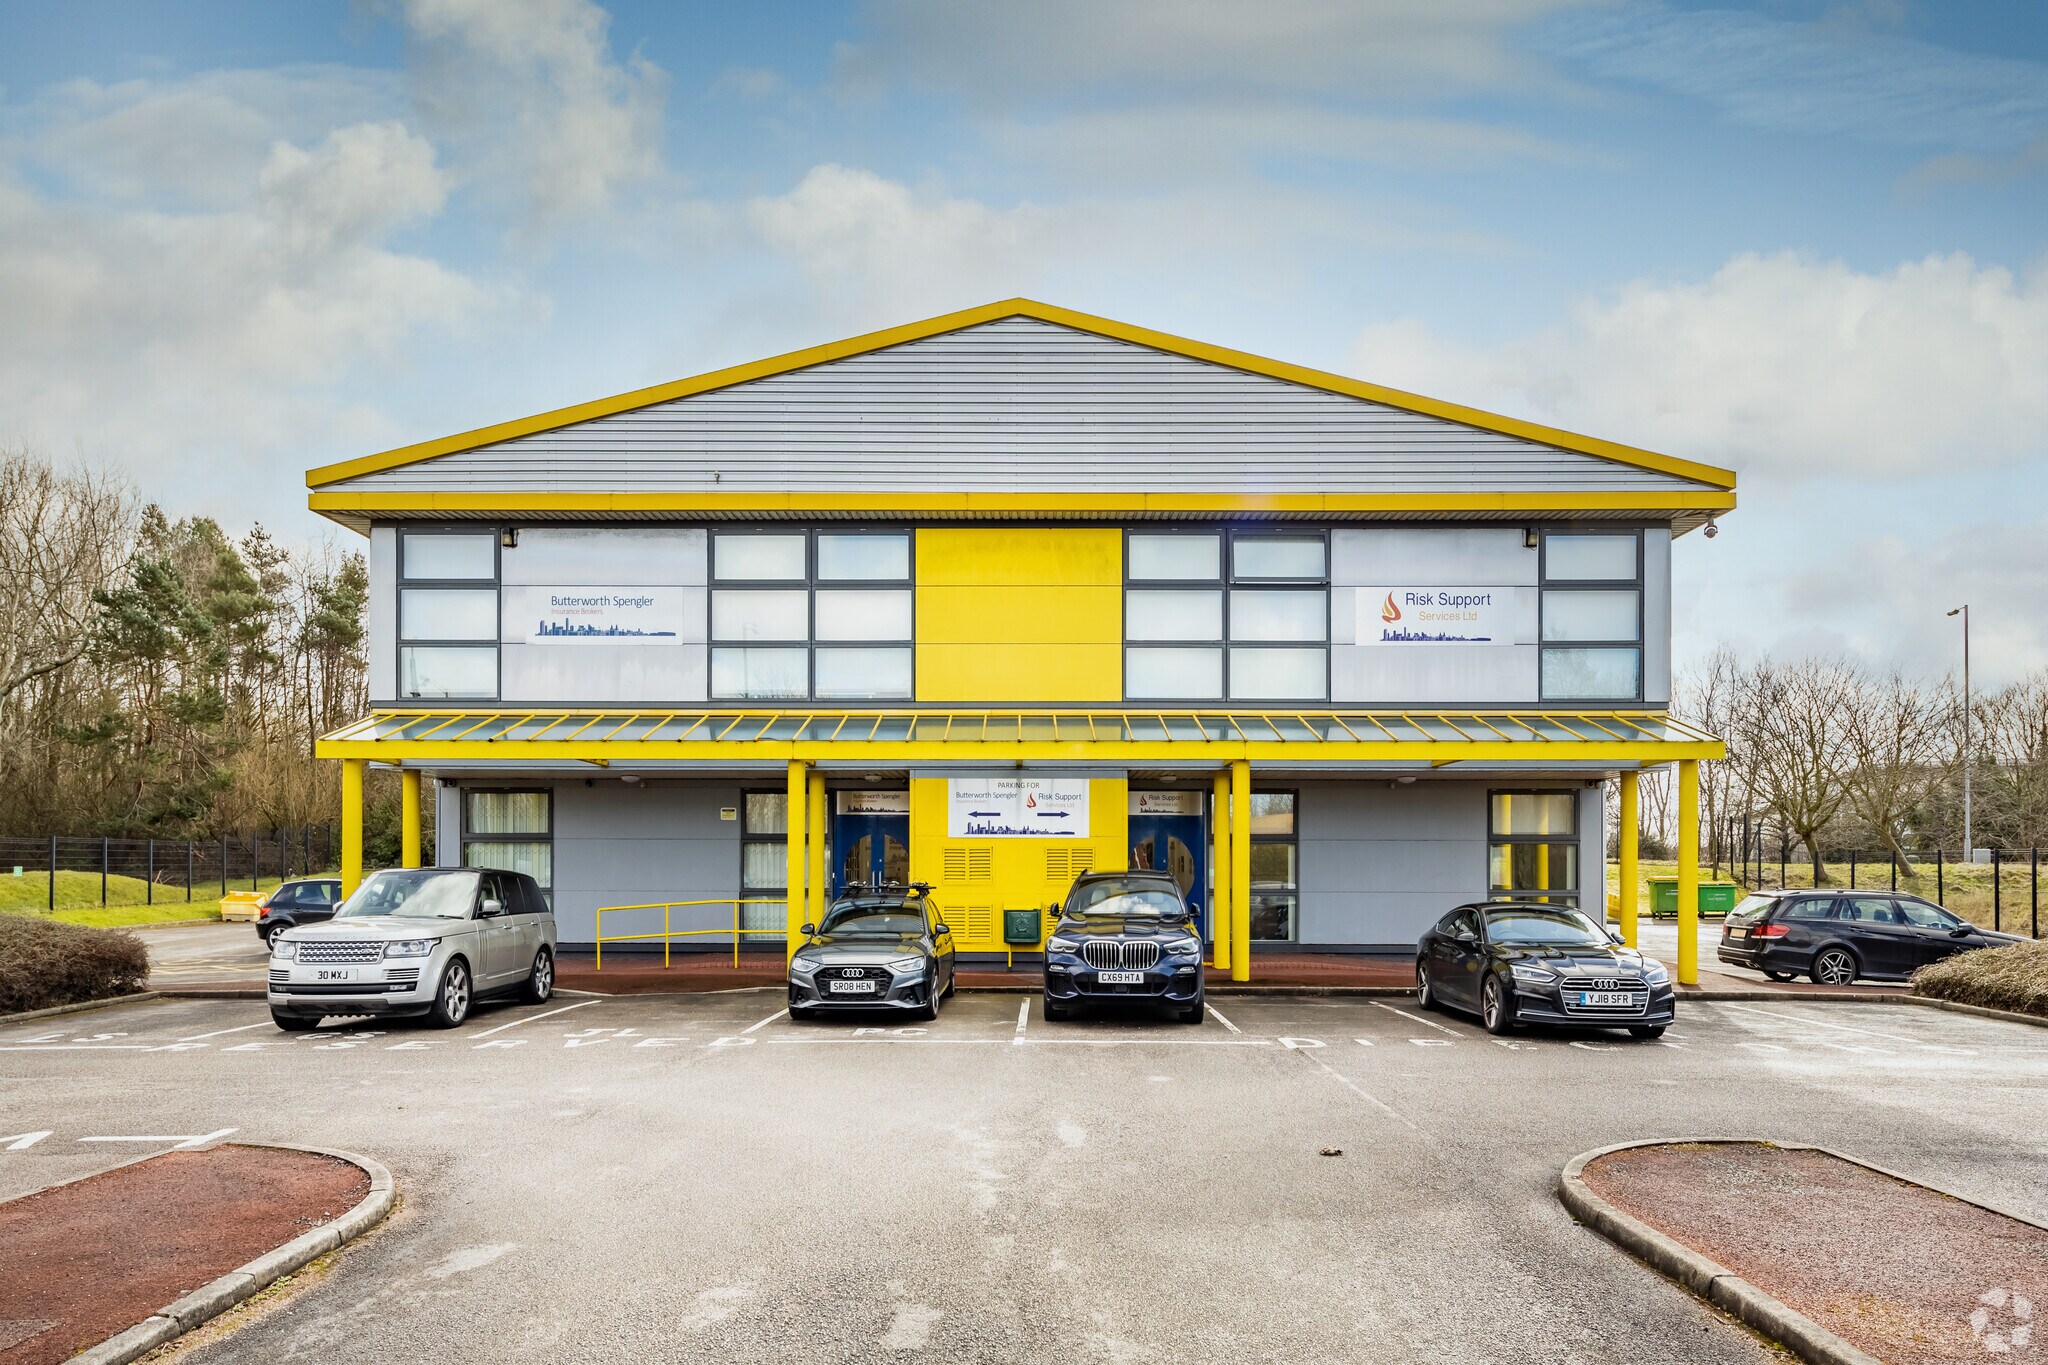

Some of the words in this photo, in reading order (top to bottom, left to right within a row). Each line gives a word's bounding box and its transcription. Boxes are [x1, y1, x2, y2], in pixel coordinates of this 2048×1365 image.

[551, 595, 610, 606] Butterworth
[613, 595, 654, 608] Spengler
[1405, 592, 1434, 606] Risk
[1438, 592, 1491, 609] Support
[1419, 611, 1460, 621] Services
[1463, 611, 1477, 621] Ltd
[956, 791, 991, 799] Butterworth
[993, 791, 1018, 800] Spengler
[1055, 793, 1082, 802] Support
[317, 970, 329, 979] 30
[330, 970, 348, 980] MXJ
[1101, 973, 1123, 982] CX69
[1124, 973, 1140, 982] HTA
[833, 982, 854, 991] SR08
[856, 982, 872, 991] HEN
[1589, 995, 1608, 1003] YJ18
[1611, 995, 1628, 1004] SFR
[143, 1037, 758, 1052] RESERVED
